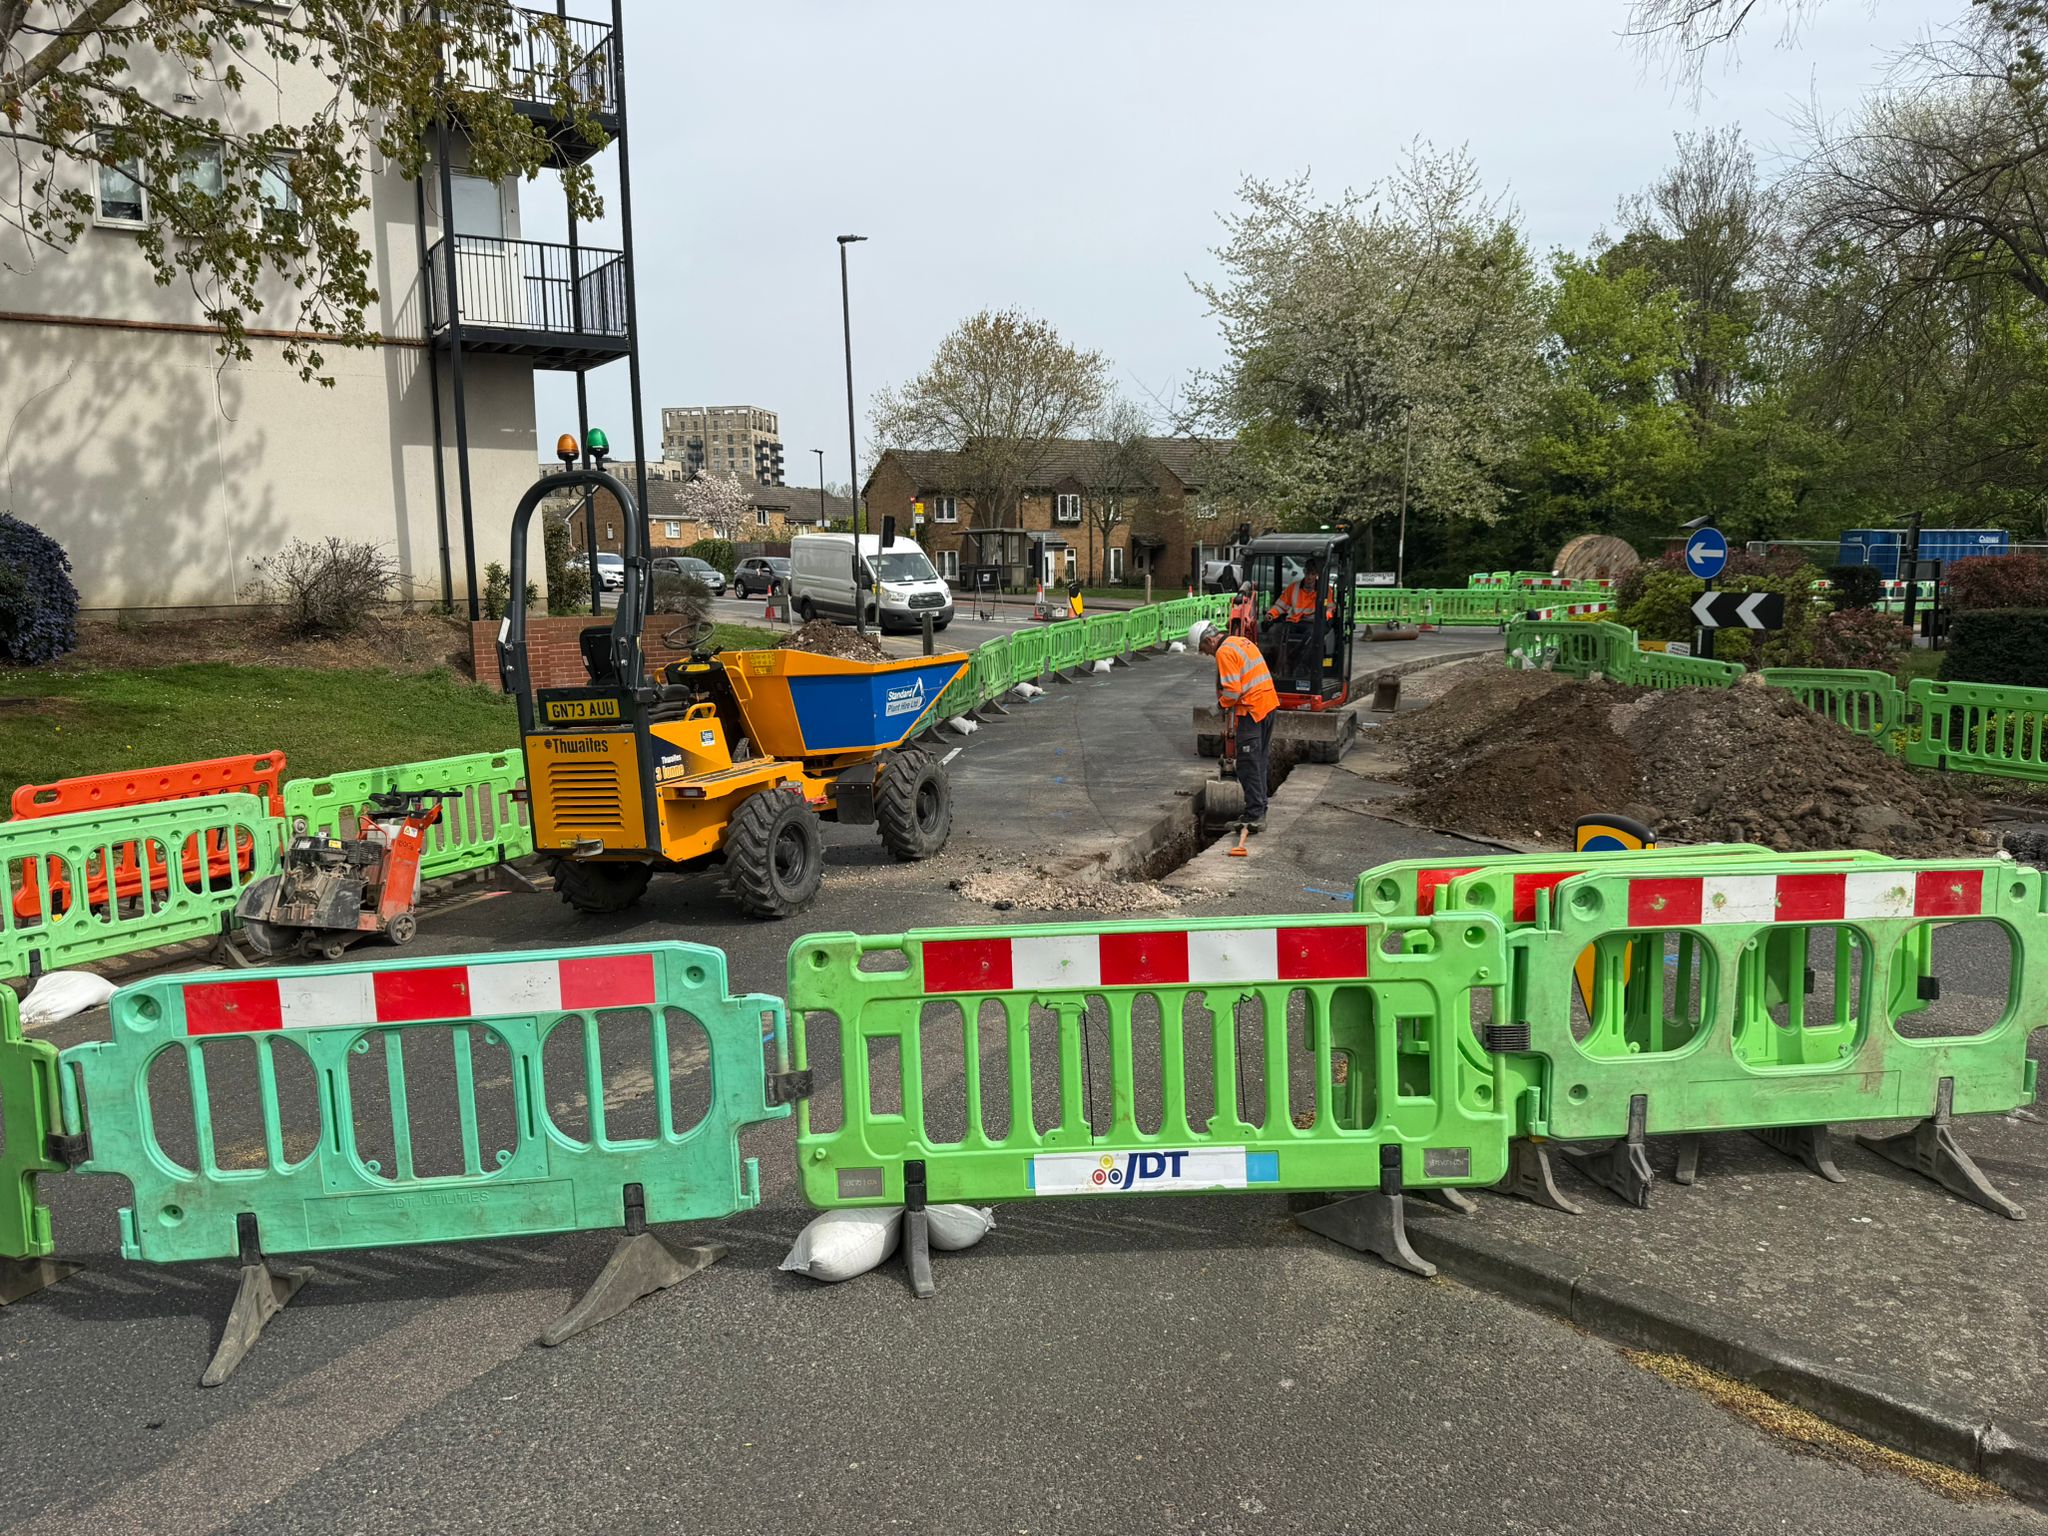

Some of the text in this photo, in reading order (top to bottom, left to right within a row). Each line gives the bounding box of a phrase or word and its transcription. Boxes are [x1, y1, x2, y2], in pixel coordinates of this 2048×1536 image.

[888, 688, 913, 701] Standard
[552, 701, 614, 718] GN73 AUU
[888, 703, 900, 712] Plant
[552, 738, 608, 753] Thwaites
[661, 754, 682, 764] Thwaites
[655, 764, 684, 781] 3 tonne
[1120, 1151, 1189, 1189] JDT
[388, 1191, 490, 1209] JDT UTILITIES
